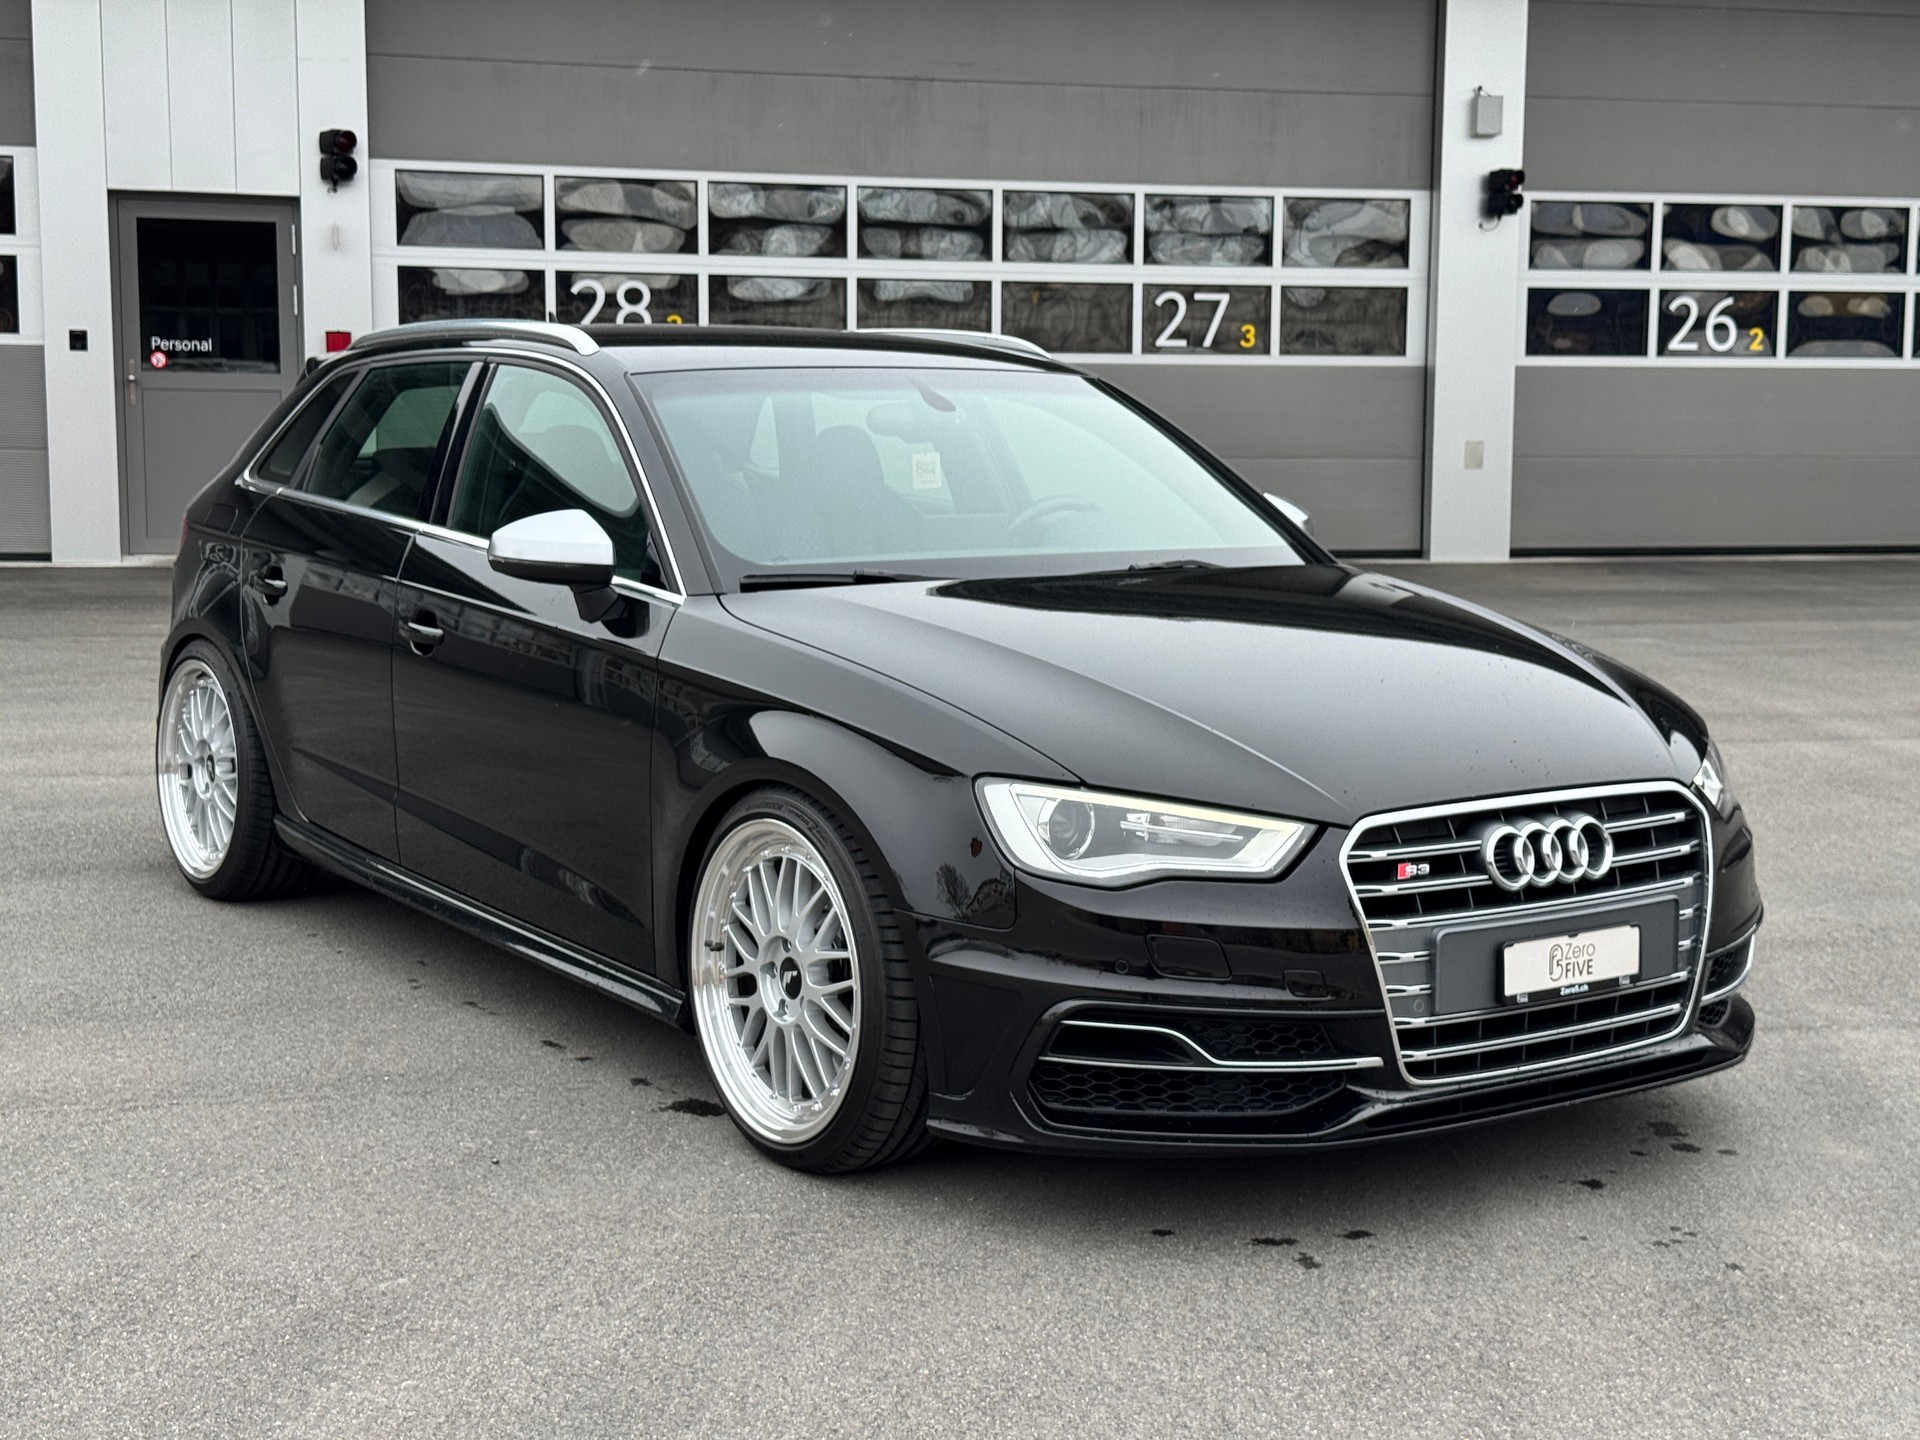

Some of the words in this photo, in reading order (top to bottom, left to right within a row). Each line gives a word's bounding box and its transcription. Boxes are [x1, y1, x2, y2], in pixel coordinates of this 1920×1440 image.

[570, 279, 653, 325] 28
[1154, 290, 1231, 348] 27
[1240, 323, 1256, 348] 3
[1667, 295, 1738, 353] 26
[1748, 327, 1765, 352] 2
[150, 335, 213, 352] Personal
[1564, 942, 1596, 960] Zero
[1565, 958, 1594, 979] FIVE
